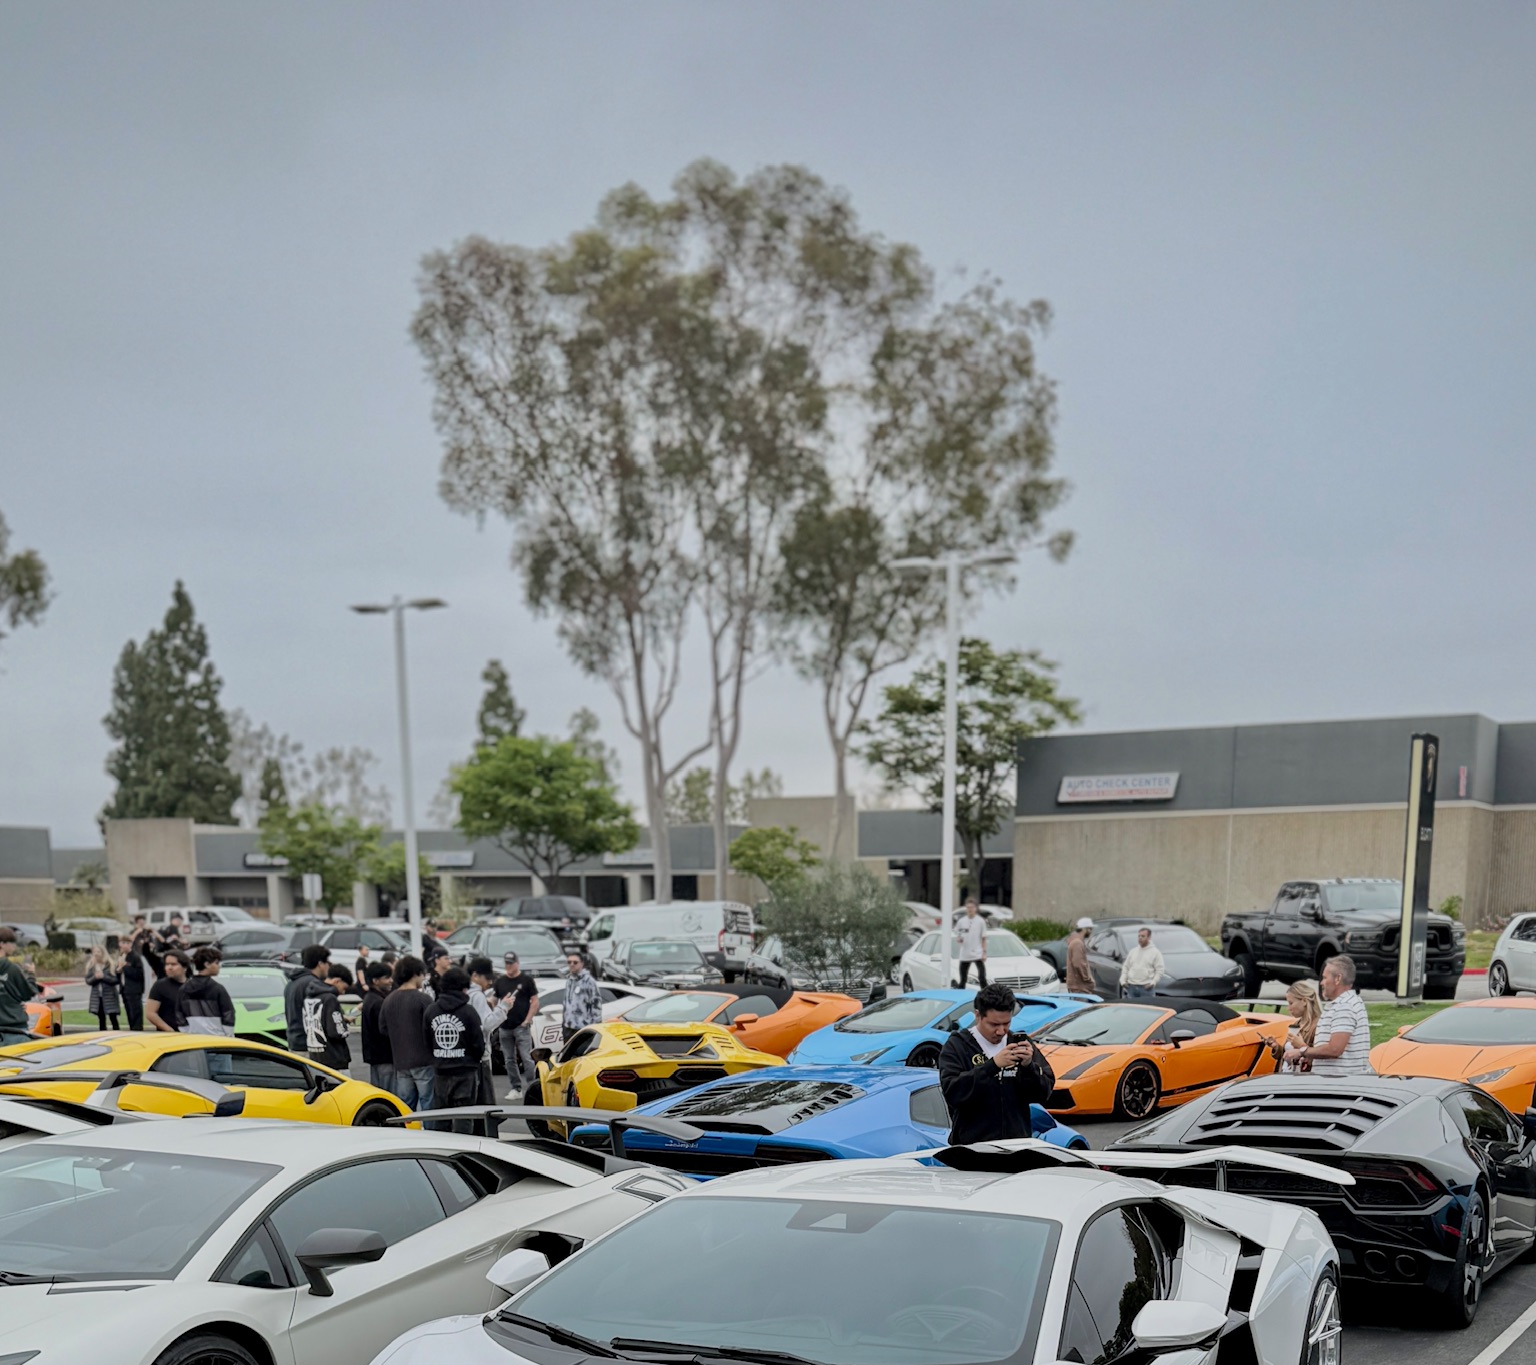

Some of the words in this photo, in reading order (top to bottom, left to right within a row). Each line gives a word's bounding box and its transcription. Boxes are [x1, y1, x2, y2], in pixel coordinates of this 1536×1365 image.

[1066, 779, 1093, 789] AUTO
[1095, 778, 1128, 789] CHECK
[1131, 776, 1171, 787] CENTER
[450, 1014, 466, 1032] CLUB
